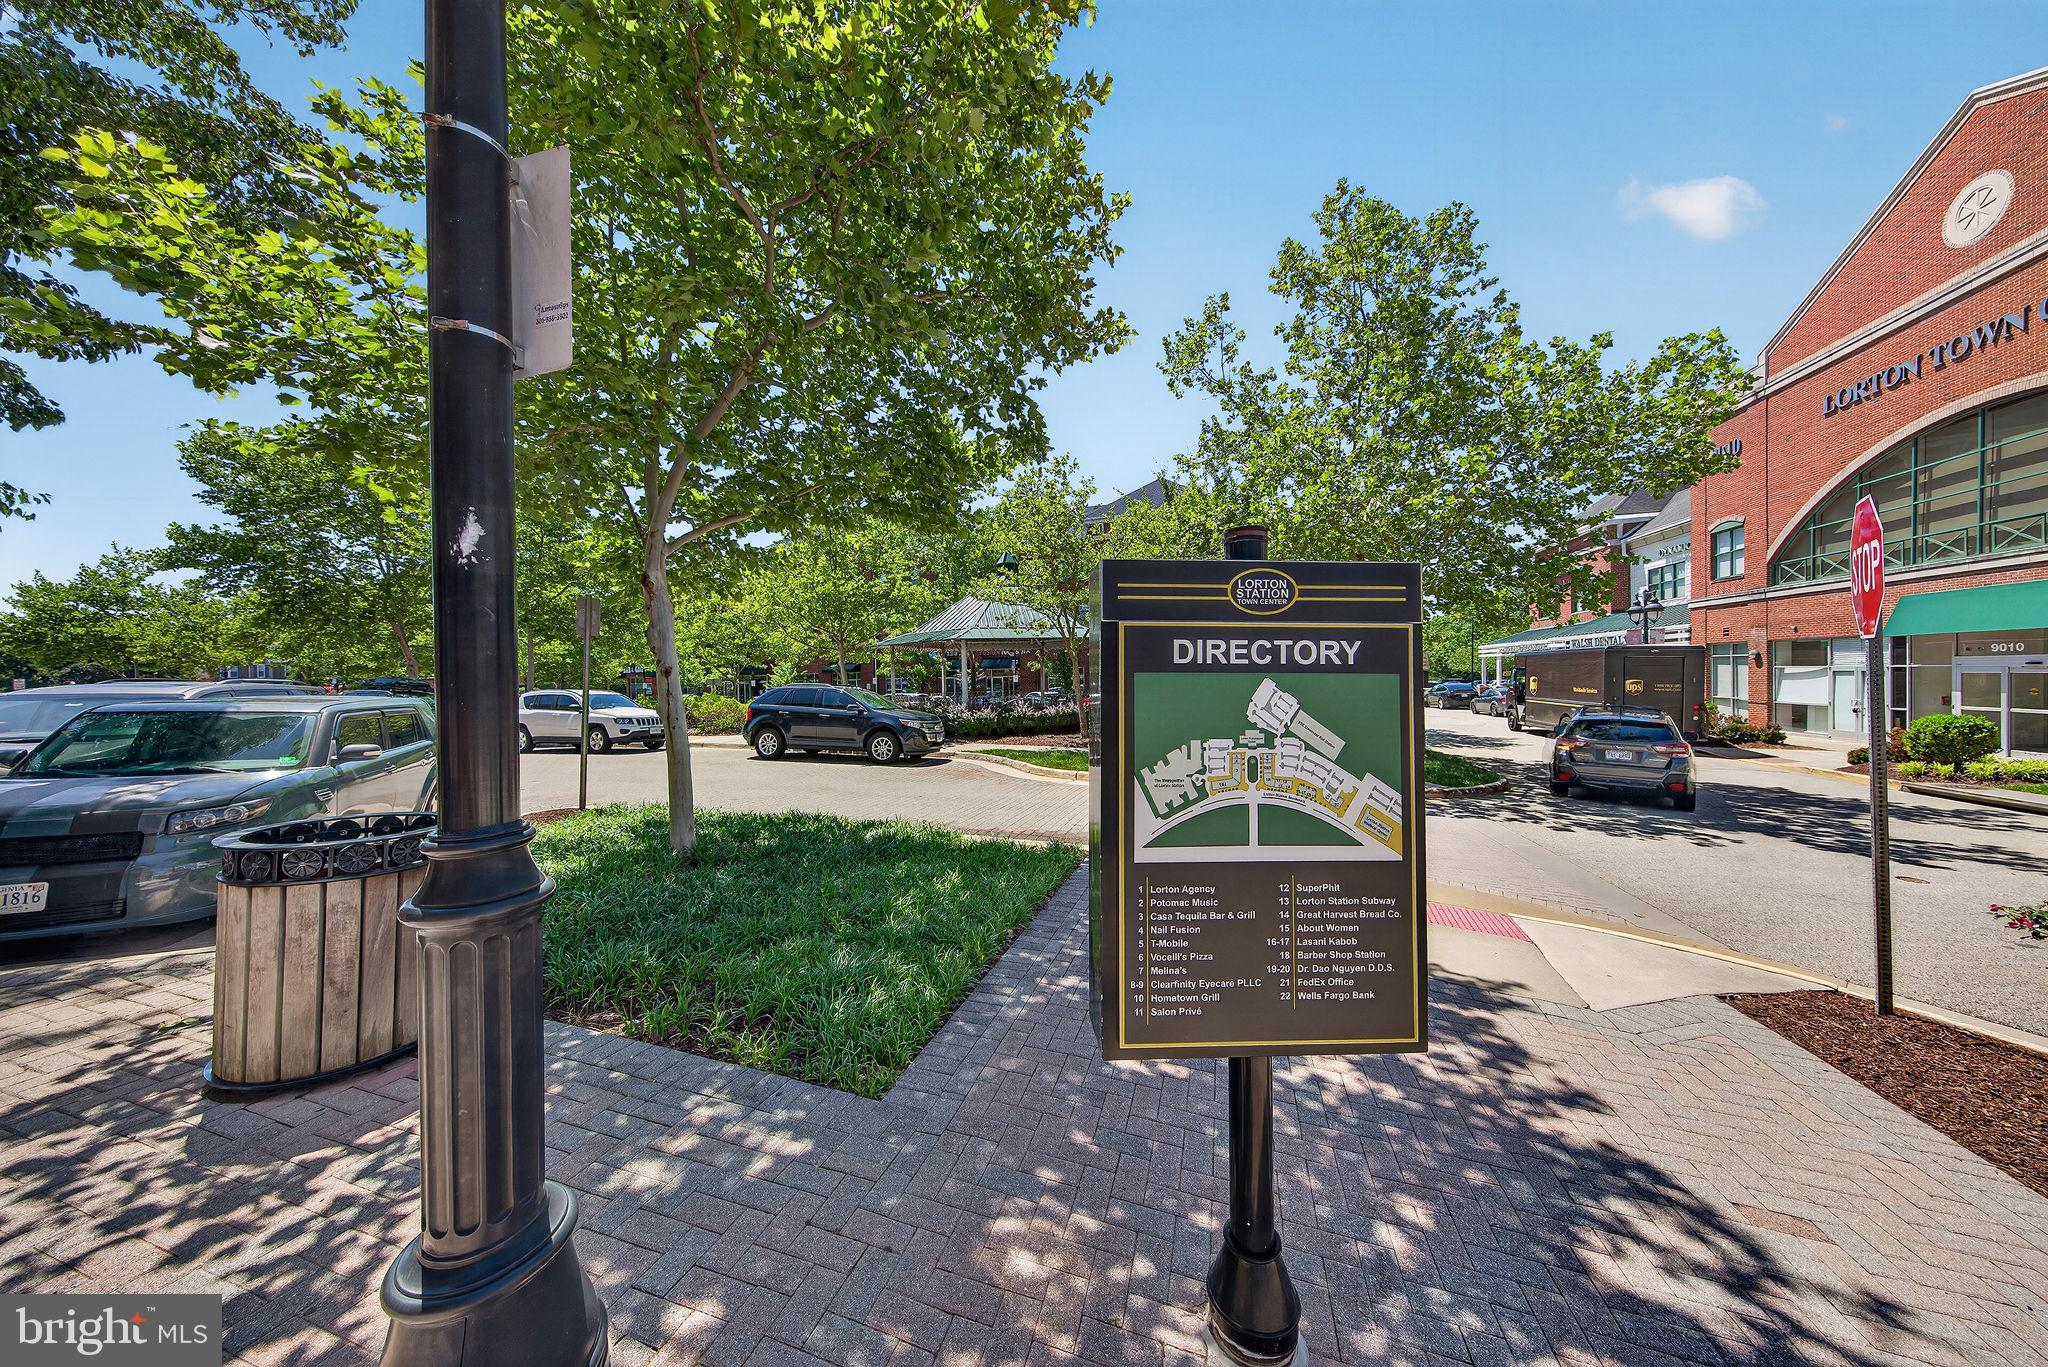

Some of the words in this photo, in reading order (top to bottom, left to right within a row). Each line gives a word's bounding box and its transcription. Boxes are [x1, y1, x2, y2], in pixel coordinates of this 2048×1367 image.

[1823, 353, 1923, 418] LORTON
[1927, 304, 2032, 372] TOWN
[1852, 538, 1880, 596] STOP
[1238, 579, 1287, 589] LORTON
[1236, 588, 1289, 599] STATION
[1570, 637, 1593, 648] WALSH
[1991, 642, 2025, 652] 9010
[1172, 638, 1362, 665] DIRECTORY
[1627, 682, 1642, 693] ups
[1150, 886, 1179, 894] Lorton
[1182, 886, 1216, 894] Agency
[1279, 884, 1289, 892] 12
[1296, 884, 1340, 893] SuperPhit
[1, 890, 42, 907] 1816
[1150, 899, 1190, 907] Potomac
[1192, 898, 1219, 906] Music
[1328, 897, 1359, 905] Station
[1362, 896, 1396, 906] Subway
[1138, 913, 1144, 921] 3
[1150, 912, 1172, 920] Casa
[1175, 912, 1207, 921] Tequila
[1237, 911, 1256, 919] Grill
[1296, 911, 1320, 919] Great
[1324, 910, 1357, 918] Harvest
[1360, 910, 1385, 918] Bread
[1388, 910, 1402, 918] Co.
[1150, 926, 1167, 934] Nail
[1170, 926, 1200, 934] Fusion
[1280, 924, 1290, 932] 15
[1297, 924, 1324, 932] About
[1326, 924, 1359, 932] Women
[1138, 940, 1144, 948] 5
[1266, 938, 1290, 946] 16-17
[1297, 938, 1326, 946] Lasani
[1329, 937, 1358, 945] Kabob
[1150, 953, 1187, 961] Vocelli's
[1298, 951, 1327, 959] Barber
[1330, 951, 1352, 960] Shop
[1355, 950, 1386, 958] Station
[1138, 967, 1144, 975] 7
[1150, 967, 1187, 975] Melina's
[1266, 965, 1290, 973] 19-20
[1298, 964, 1309, 972] Dr.
[1312, 964, 1330, 972] Dao
[1332, 964, 1366, 974] Nguyen
[1368, 964, 1394, 972] D.D.S.
[1130, 981, 1144, 989] 8-9
[1151, 980, 1196, 989] Clearfinity
[1199, 980, 1234, 988] Eyecare
[1237, 979, 1262, 987] PLLC
[1298, 978, 1325, 986] FedEx
[1328, 978, 1354, 986] Office
[1151, 994, 1198, 1002] Hometown
[1201, 994, 1220, 1002] Grill
[1280, 992, 1290, 1000] 22
[1298, 992, 1321, 1000] Wells
[1324, 992, 1350, 1001] Fargo
[1352, 991, 1375, 999] Bank
[1150, 1008, 1176, 1016] Salon
[1179, 1007, 1202, 1016] Privé
